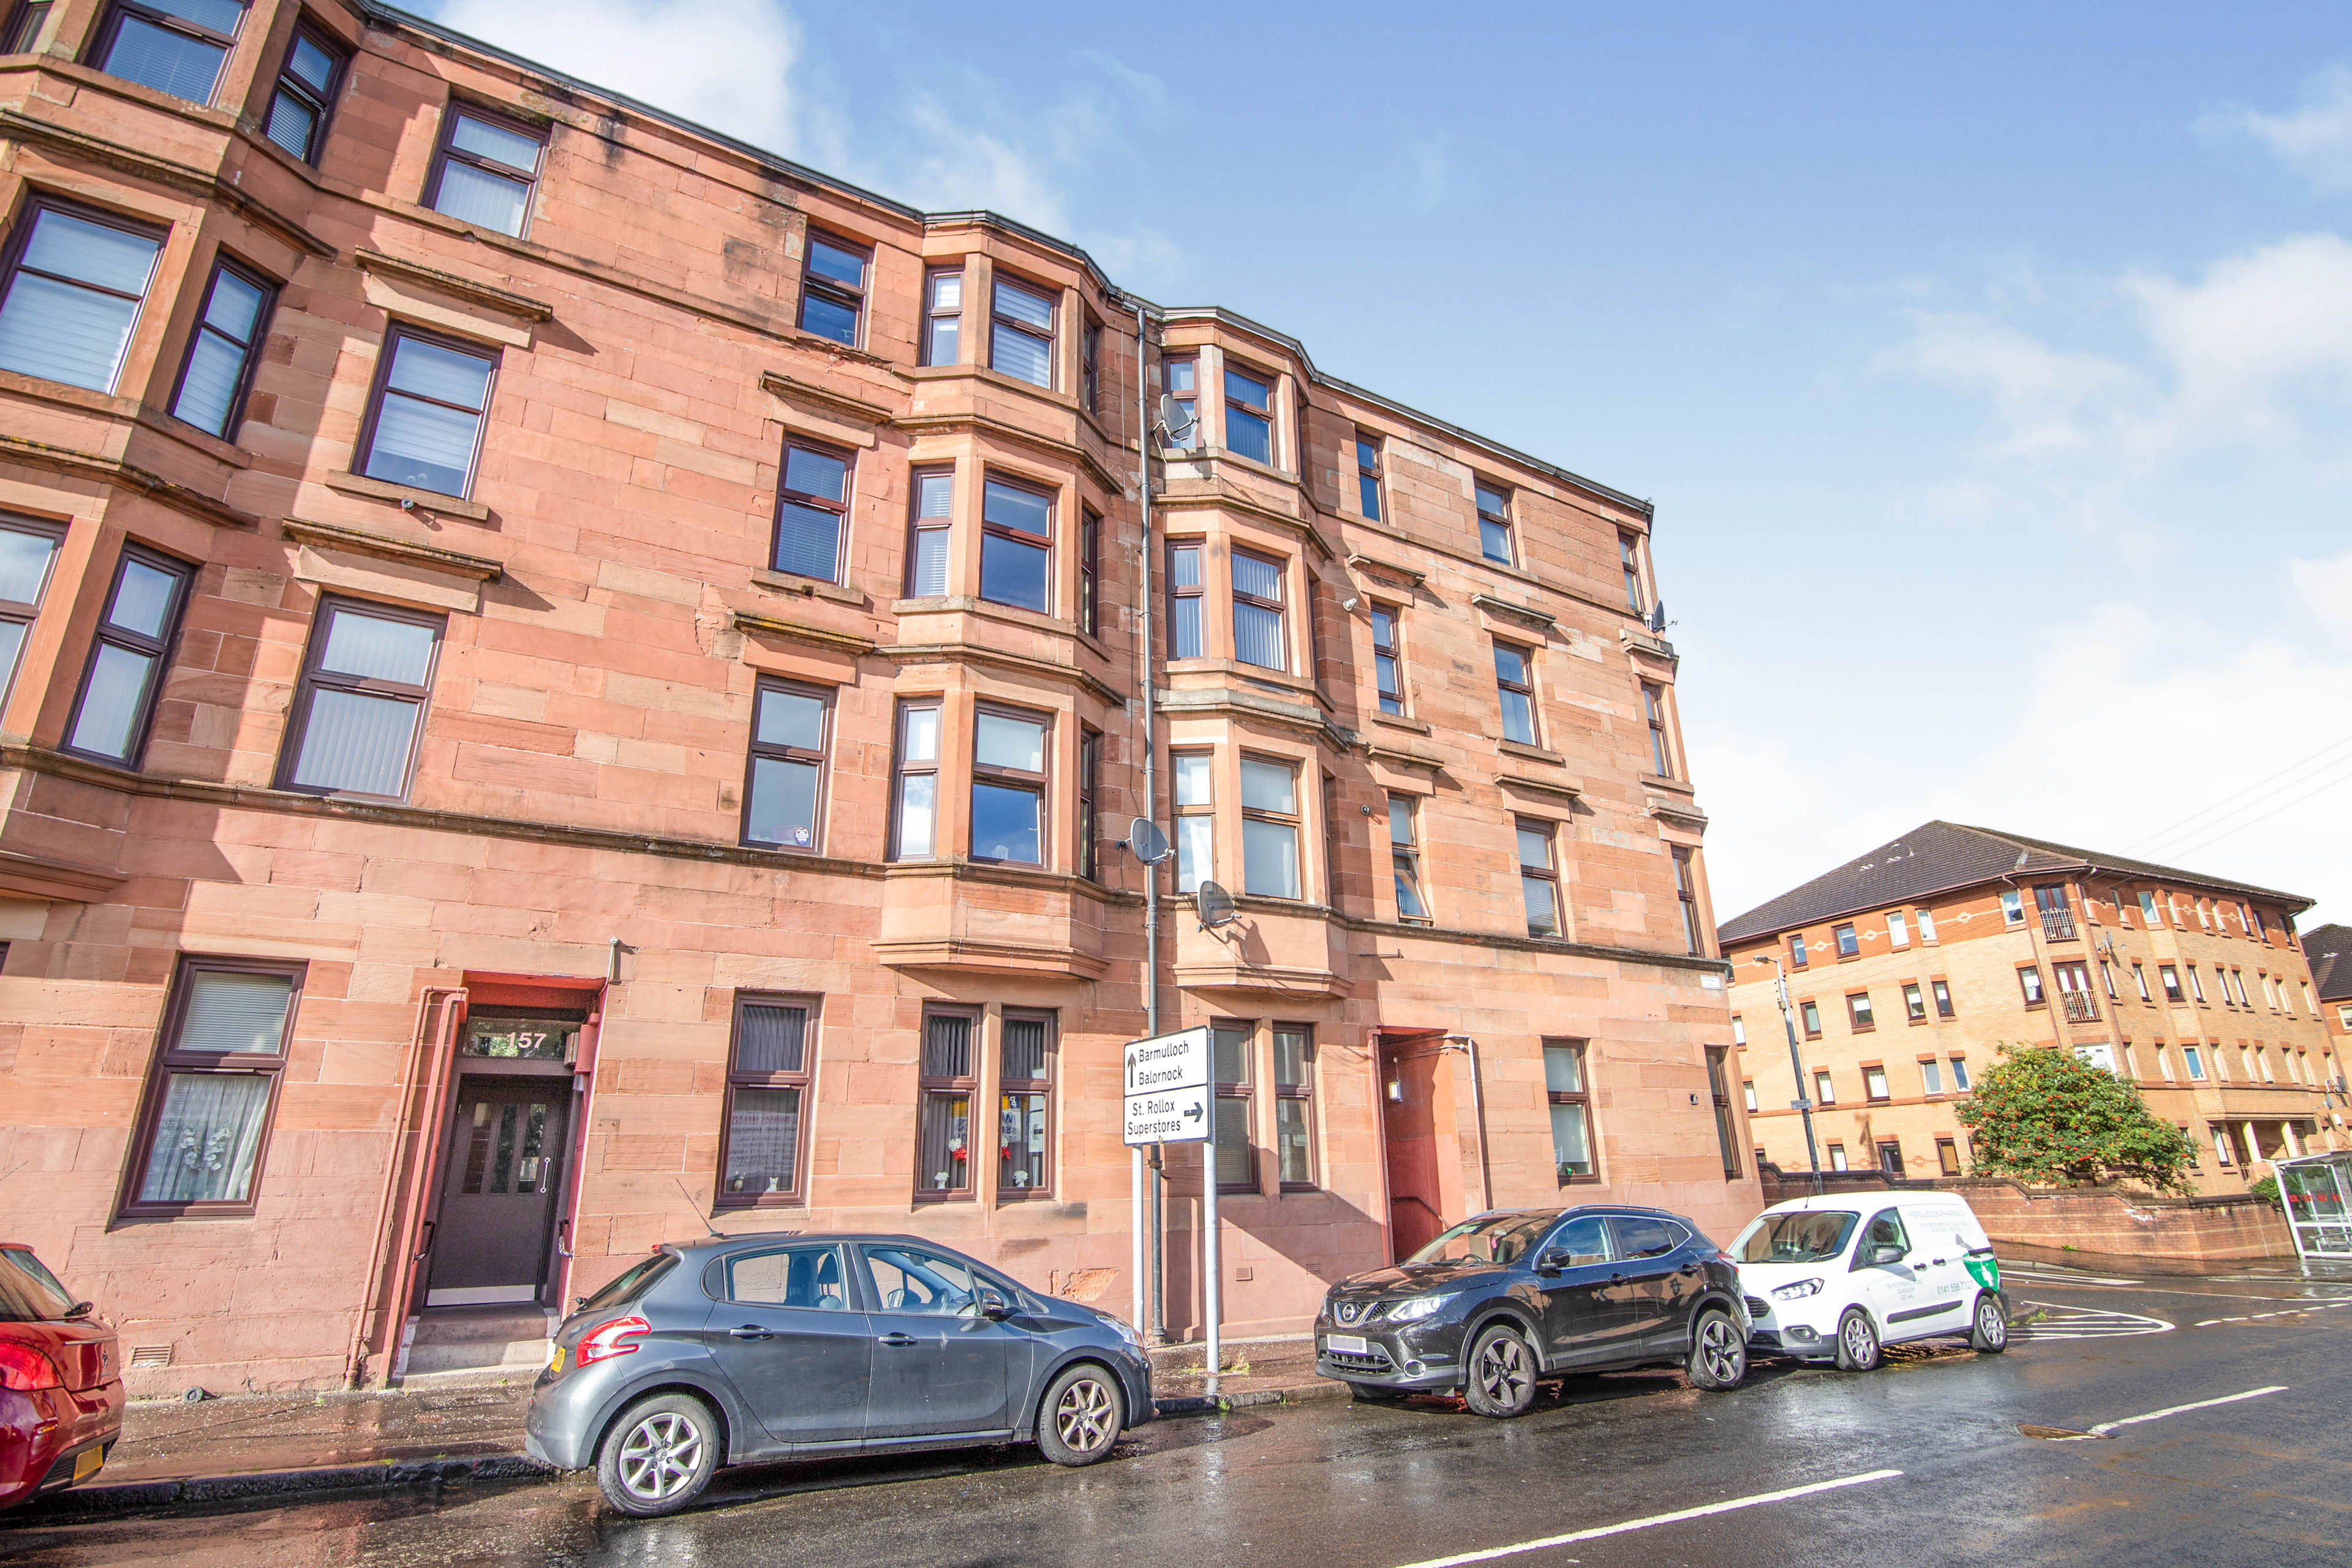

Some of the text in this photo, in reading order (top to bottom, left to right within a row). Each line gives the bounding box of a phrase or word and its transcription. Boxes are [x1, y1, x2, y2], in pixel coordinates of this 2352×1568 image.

[507, 1031, 547, 1049] 157
[1139, 1040, 1189, 1062] Barmulloch
[1139, 1065, 1183, 1085] Balornock
[1133, 1099, 1175, 1116] St. Rollox
[1128, 1120, 1181, 1137] Superstores
[1937, 1285, 1949, 1295] 0141
